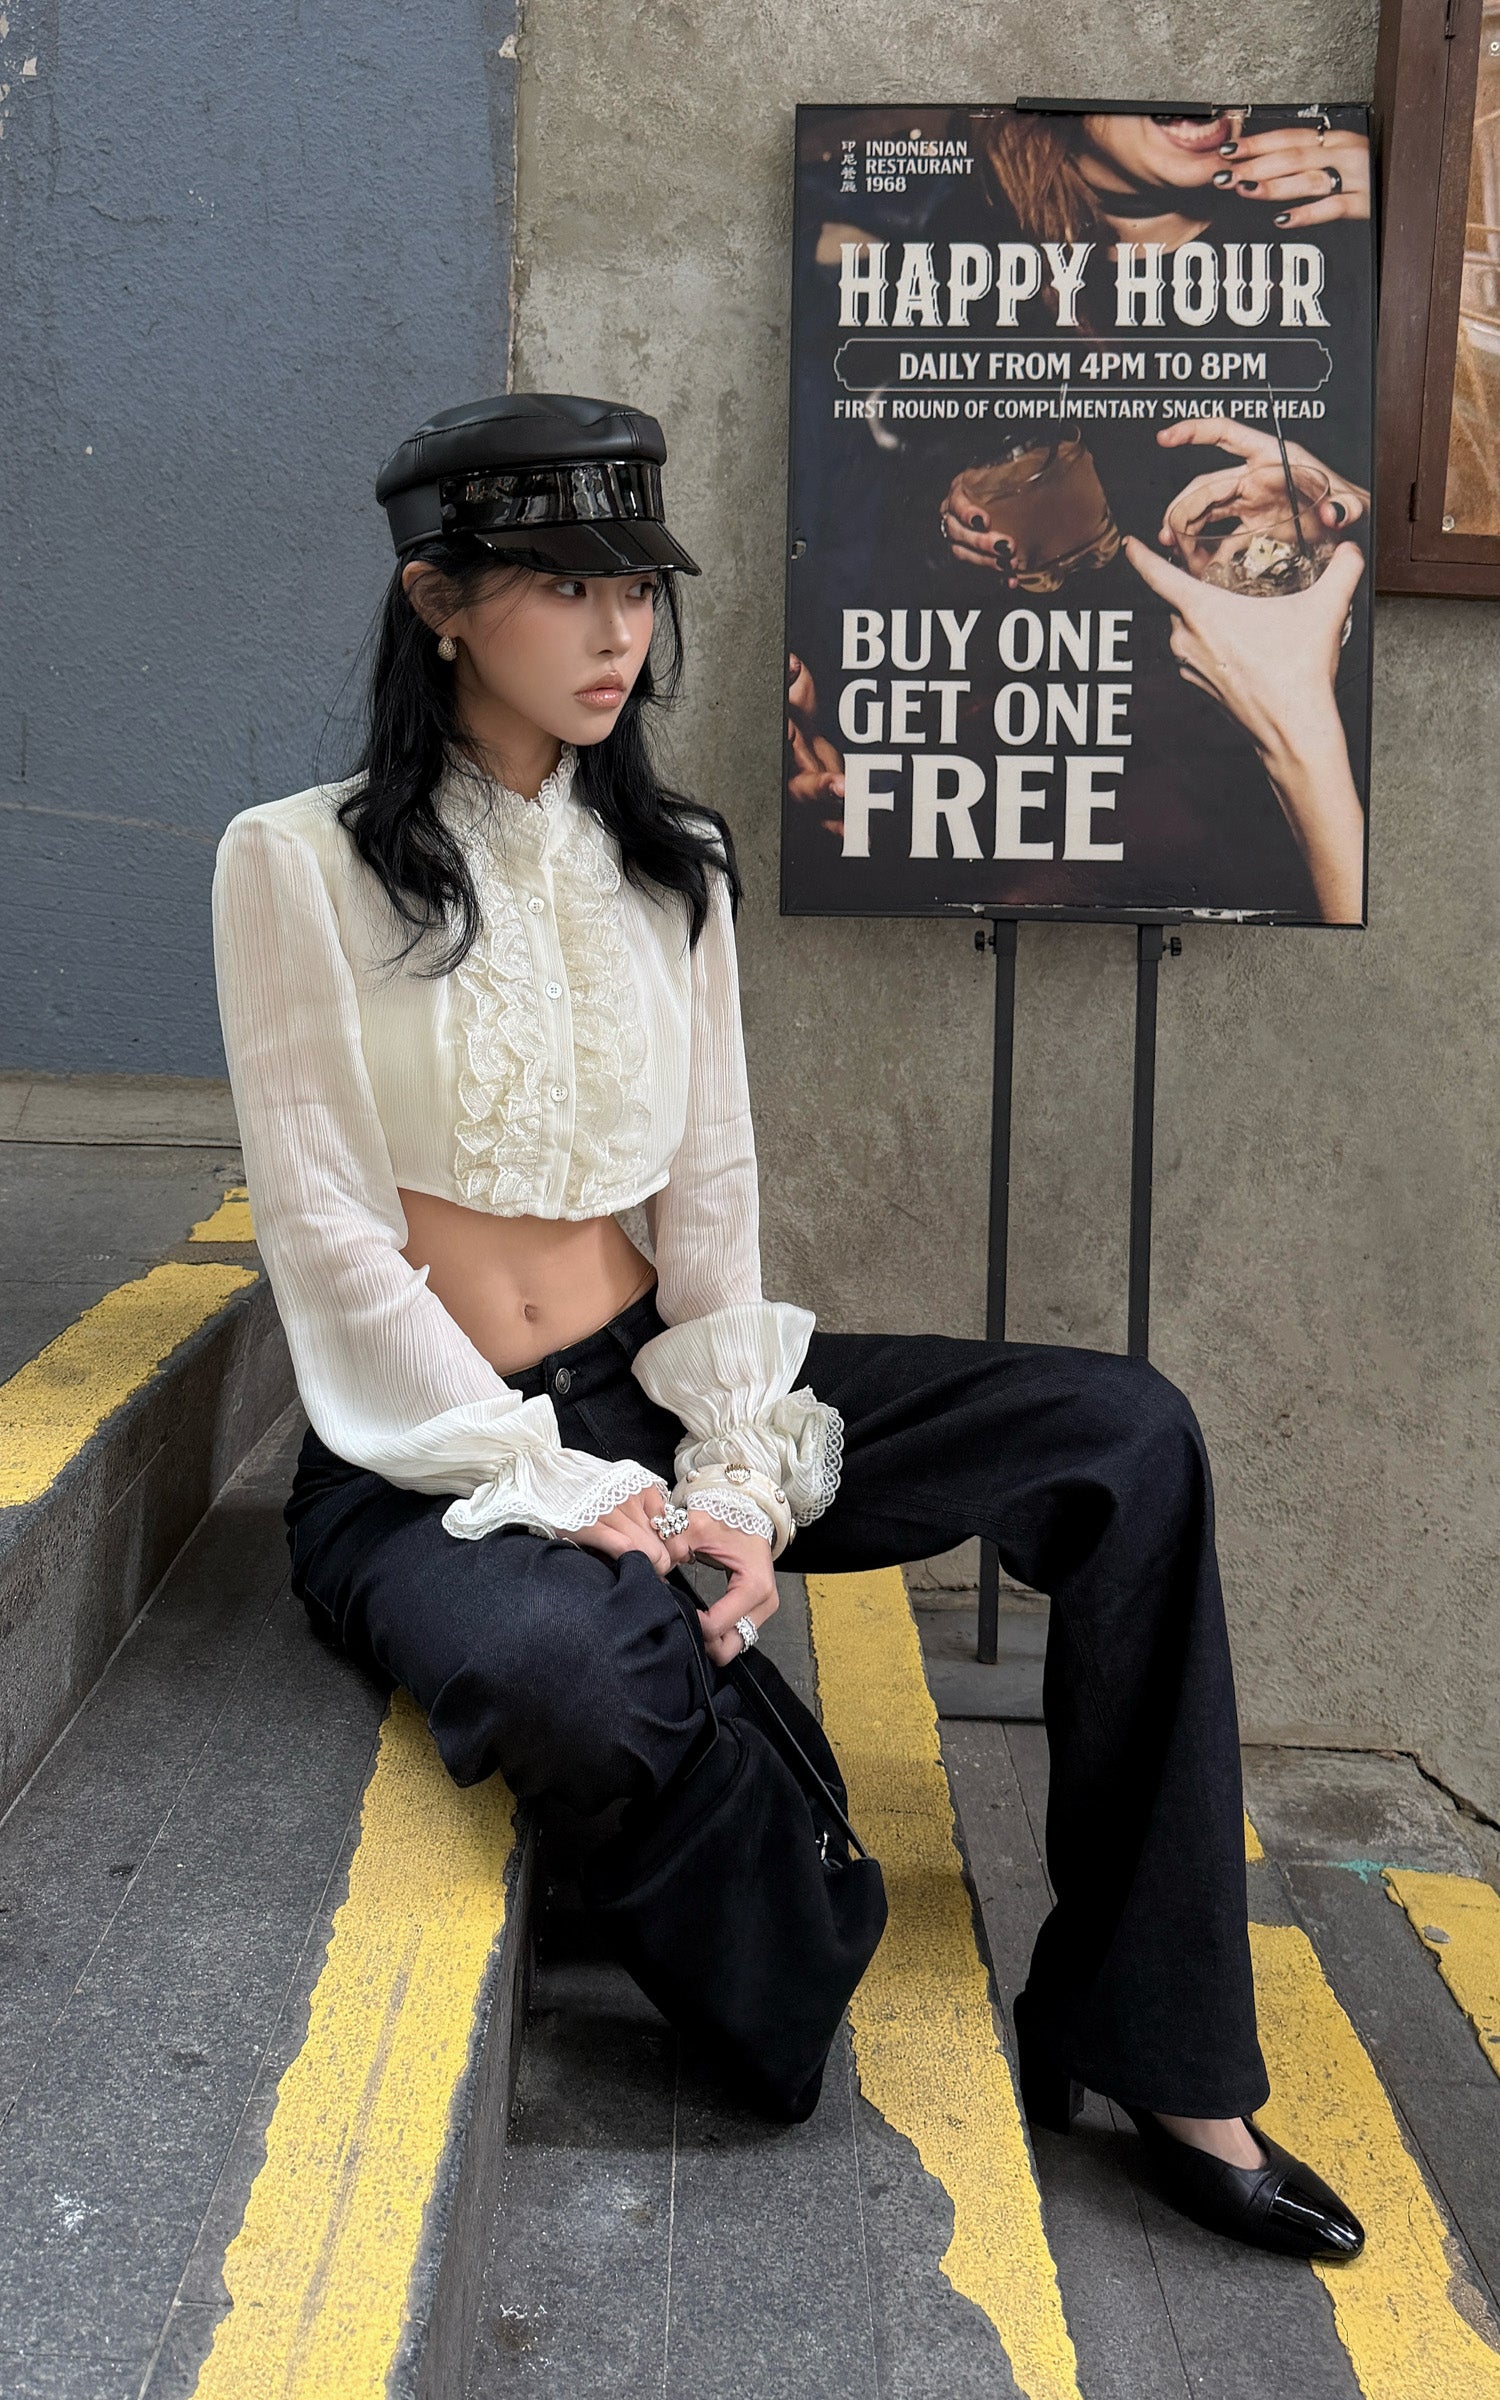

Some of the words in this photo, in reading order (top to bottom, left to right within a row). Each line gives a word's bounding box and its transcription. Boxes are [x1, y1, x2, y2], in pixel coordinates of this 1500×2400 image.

[865, 140, 968, 157] INDONESIAN
[865, 158, 975, 175] RESTAURANT
[865, 176, 907, 193] 1968
[837, 242, 1096, 328] HAPPY
[1114, 242, 1332, 328] HOUR
[899, 352, 981, 380] DAILY
[988, 352, 1071, 380] FROM
[1079, 352, 1146, 380] 4PM
[1154, 352, 1193, 380] TO
[1200, 352, 1267, 380] 8PM
[833, 400, 888, 419] FIRST
[892, 400, 960, 419] ROUND
[964, 400, 989, 419] OF
[993, 400, 1158, 419] COMPLIMENTARY
[1162, 400, 1227, 419] SNACK
[1230, 400, 1268, 419] PER
[1274, 400, 1326, 419] HEAD
[841, 609, 982, 671] BUY
[998, 609, 1133, 672] ONE
[838, 678, 971, 744] GET
[993, 682, 1132, 746] ONE
[840, 753, 1124, 861] FREE
